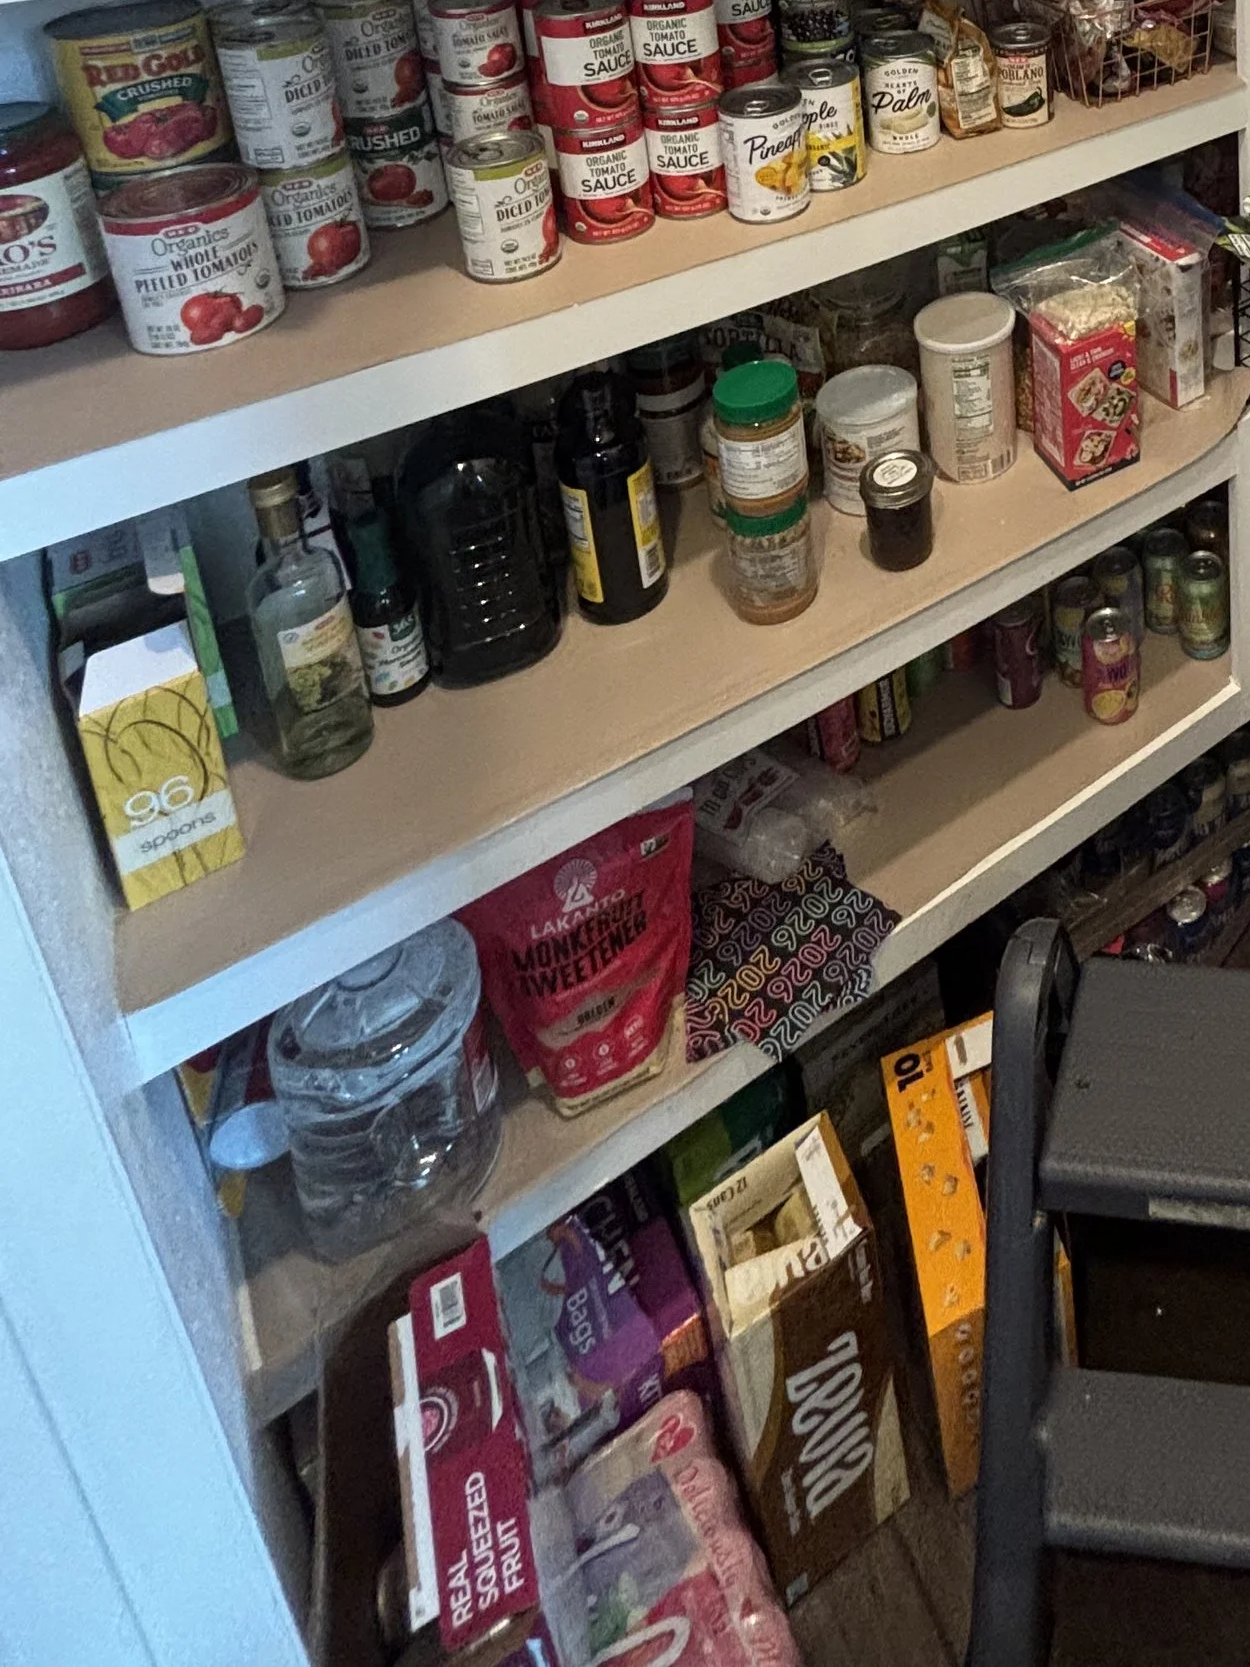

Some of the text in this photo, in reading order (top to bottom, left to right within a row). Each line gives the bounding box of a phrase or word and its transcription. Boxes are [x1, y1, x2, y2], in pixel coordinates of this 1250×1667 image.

[585, 14, 622, 29] KIRKLAND
[647, 18, 687, 30] ORGANIC
[590, 30, 624, 49] ORGANIC
[643, 39, 697, 58] SAUCE
[651, 31, 685, 42] TOMATO
[584, 50, 632, 77] SAUCE
[593, 43, 624, 60] TOMATO
[885, 68, 918, 77] GOLDEN
[116, 77, 193, 101] CRUSHED
[871, 86, 932, 114] Palm
[350, 126, 420, 151] RUSHED
[661, 132, 700, 144] ORGANIC
[664, 144, 698, 154] TOMATO
[586, 151, 627, 167] ORGANIC
[590, 163, 626, 178] TOMATO
[657, 152, 709, 169] SAUCE
[581, 169, 637, 193] SAUCE
[271, 183, 337, 206] Organics
[496, 199, 533, 222] DICED
[152, 226, 230, 257] Organics
[171, 250, 220, 272] WHOLE
[136, 271, 189, 295] PEELED
[124, 775, 194, 827] 96
[141, 812, 217, 853] spoons
[531, 888, 626, 940] LAKANTO
[771, 875, 843, 951] 2026
[512, 890, 645, 973] MONKFRUIT
[767, 924, 841, 1004] 2026
[893, 1050, 925, 1093] 10
[566, 1287, 597, 1356] Bags
[465, 1471, 499, 1611] SQUEEZED
[498, 1518, 525, 1594] FRUIT
[449, 1551, 473, 1628] REAL
